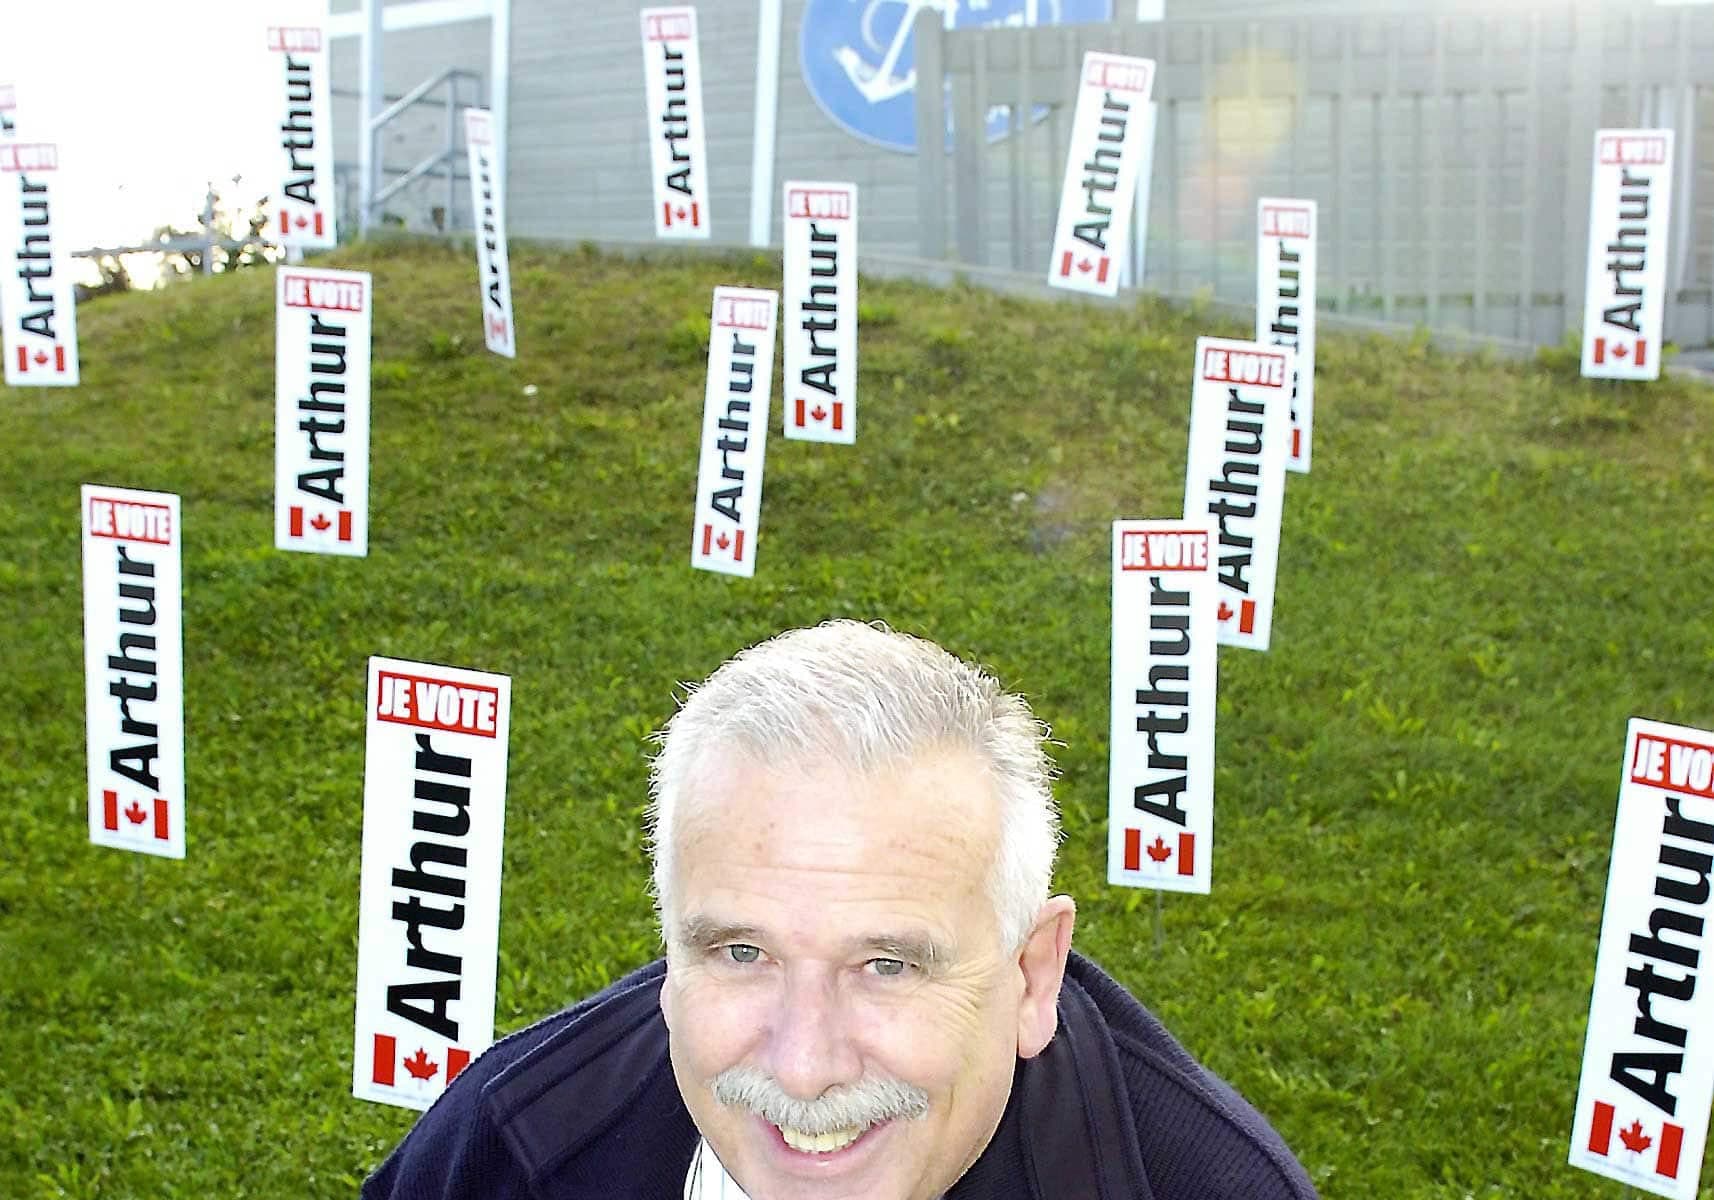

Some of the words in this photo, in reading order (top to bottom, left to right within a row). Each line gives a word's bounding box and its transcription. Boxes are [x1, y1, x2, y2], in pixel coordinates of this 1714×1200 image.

[281, 54, 316, 205] Arthur
[663, 44, 692, 196] Arthur
[1073, 92, 1129, 251] Arthur
[17, 175, 56, 339] Arthur
[801, 222, 837, 396] Arthur
[1603, 169, 1649, 333] Arthur
[297, 313, 347, 504] Arthur
[711, 333, 755, 523] Arthur
[1208, 388, 1265, 594] Arthur
[1123, 533, 1145, 568] JE
[1147, 533, 1207, 568] VOTE
[108, 545, 160, 793] Arthur
[379, 677, 411, 719] JE
[415, 682, 497, 733] VOTE
[1134, 576, 1191, 828] Arthur
[1632, 737, 1667, 782] JE
[1668, 743, 1714, 794] VO
[387, 733, 472, 1043] Arthur
[1610, 796, 1714, 1118] Arthur
